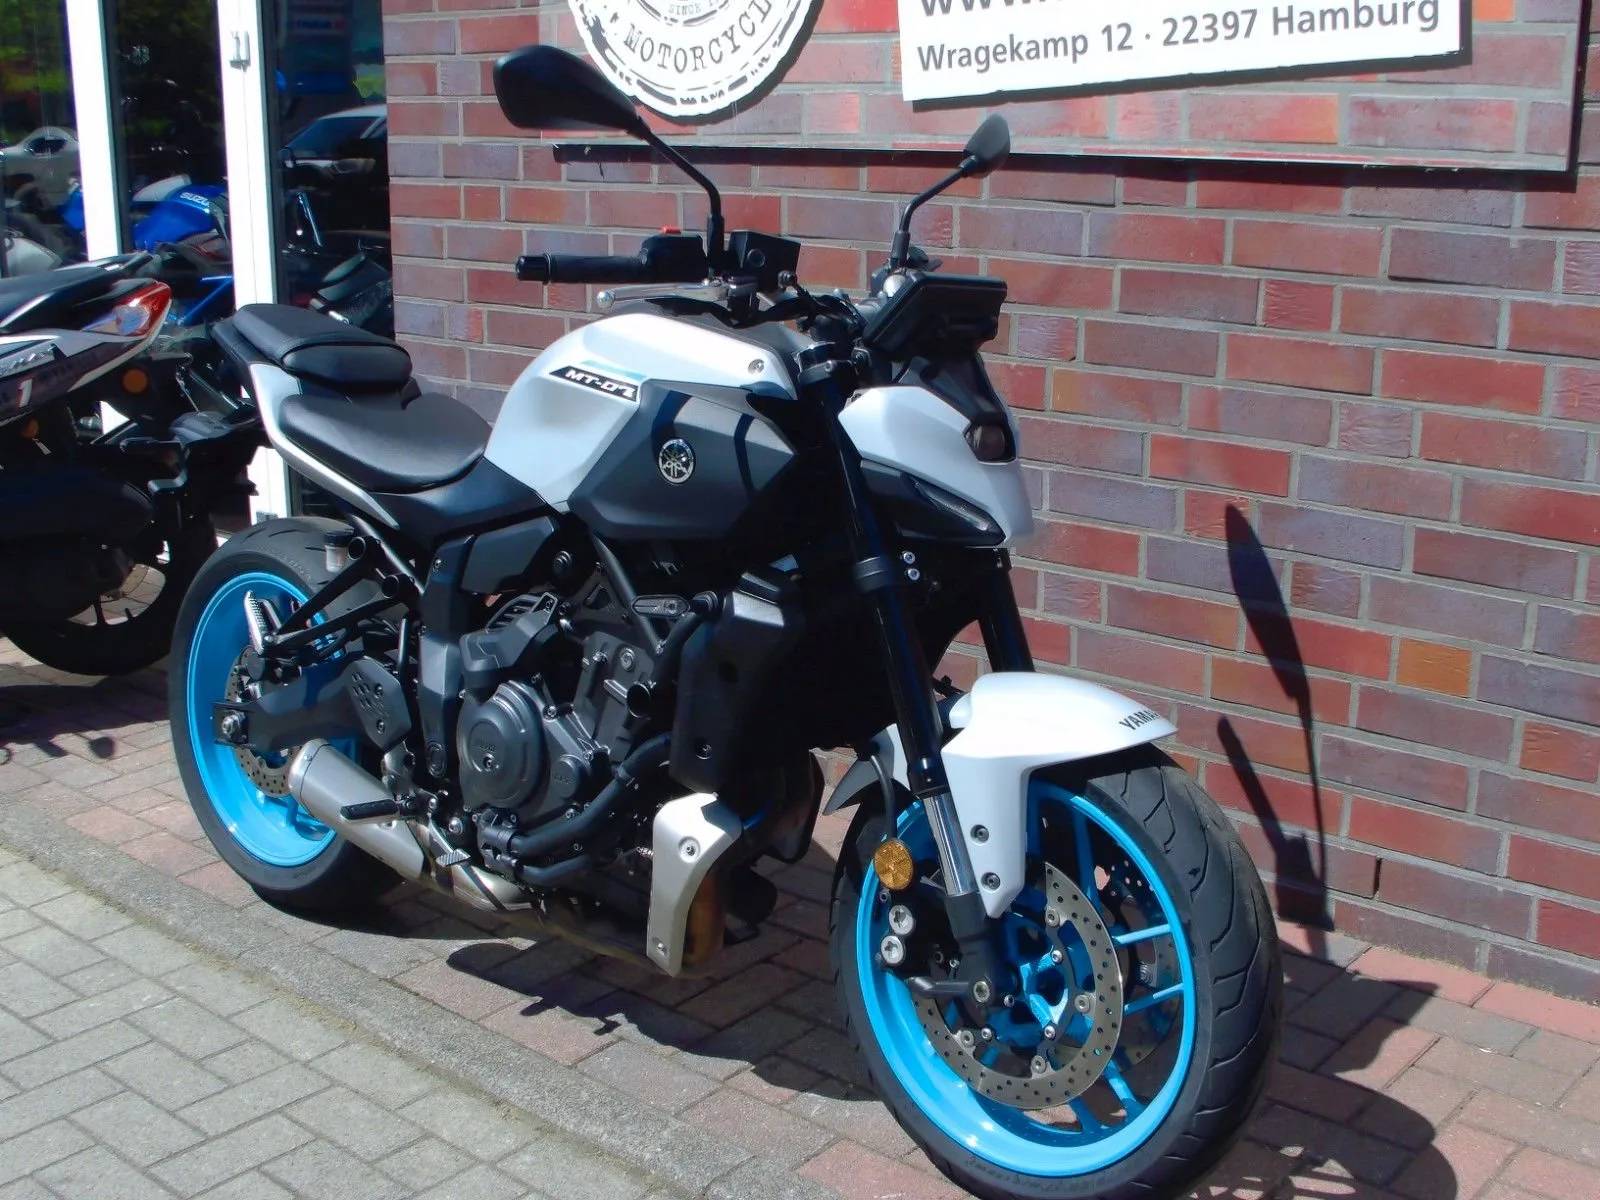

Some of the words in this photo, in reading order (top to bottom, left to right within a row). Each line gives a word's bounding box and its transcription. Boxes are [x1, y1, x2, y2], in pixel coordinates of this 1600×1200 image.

[917, 33, 1088, 74] Wragekamp
[1101, 22, 1133, 52] 12
[1162, 8, 1258, 46] 22397
[1272, 0, 1439, 36] Hamburg
